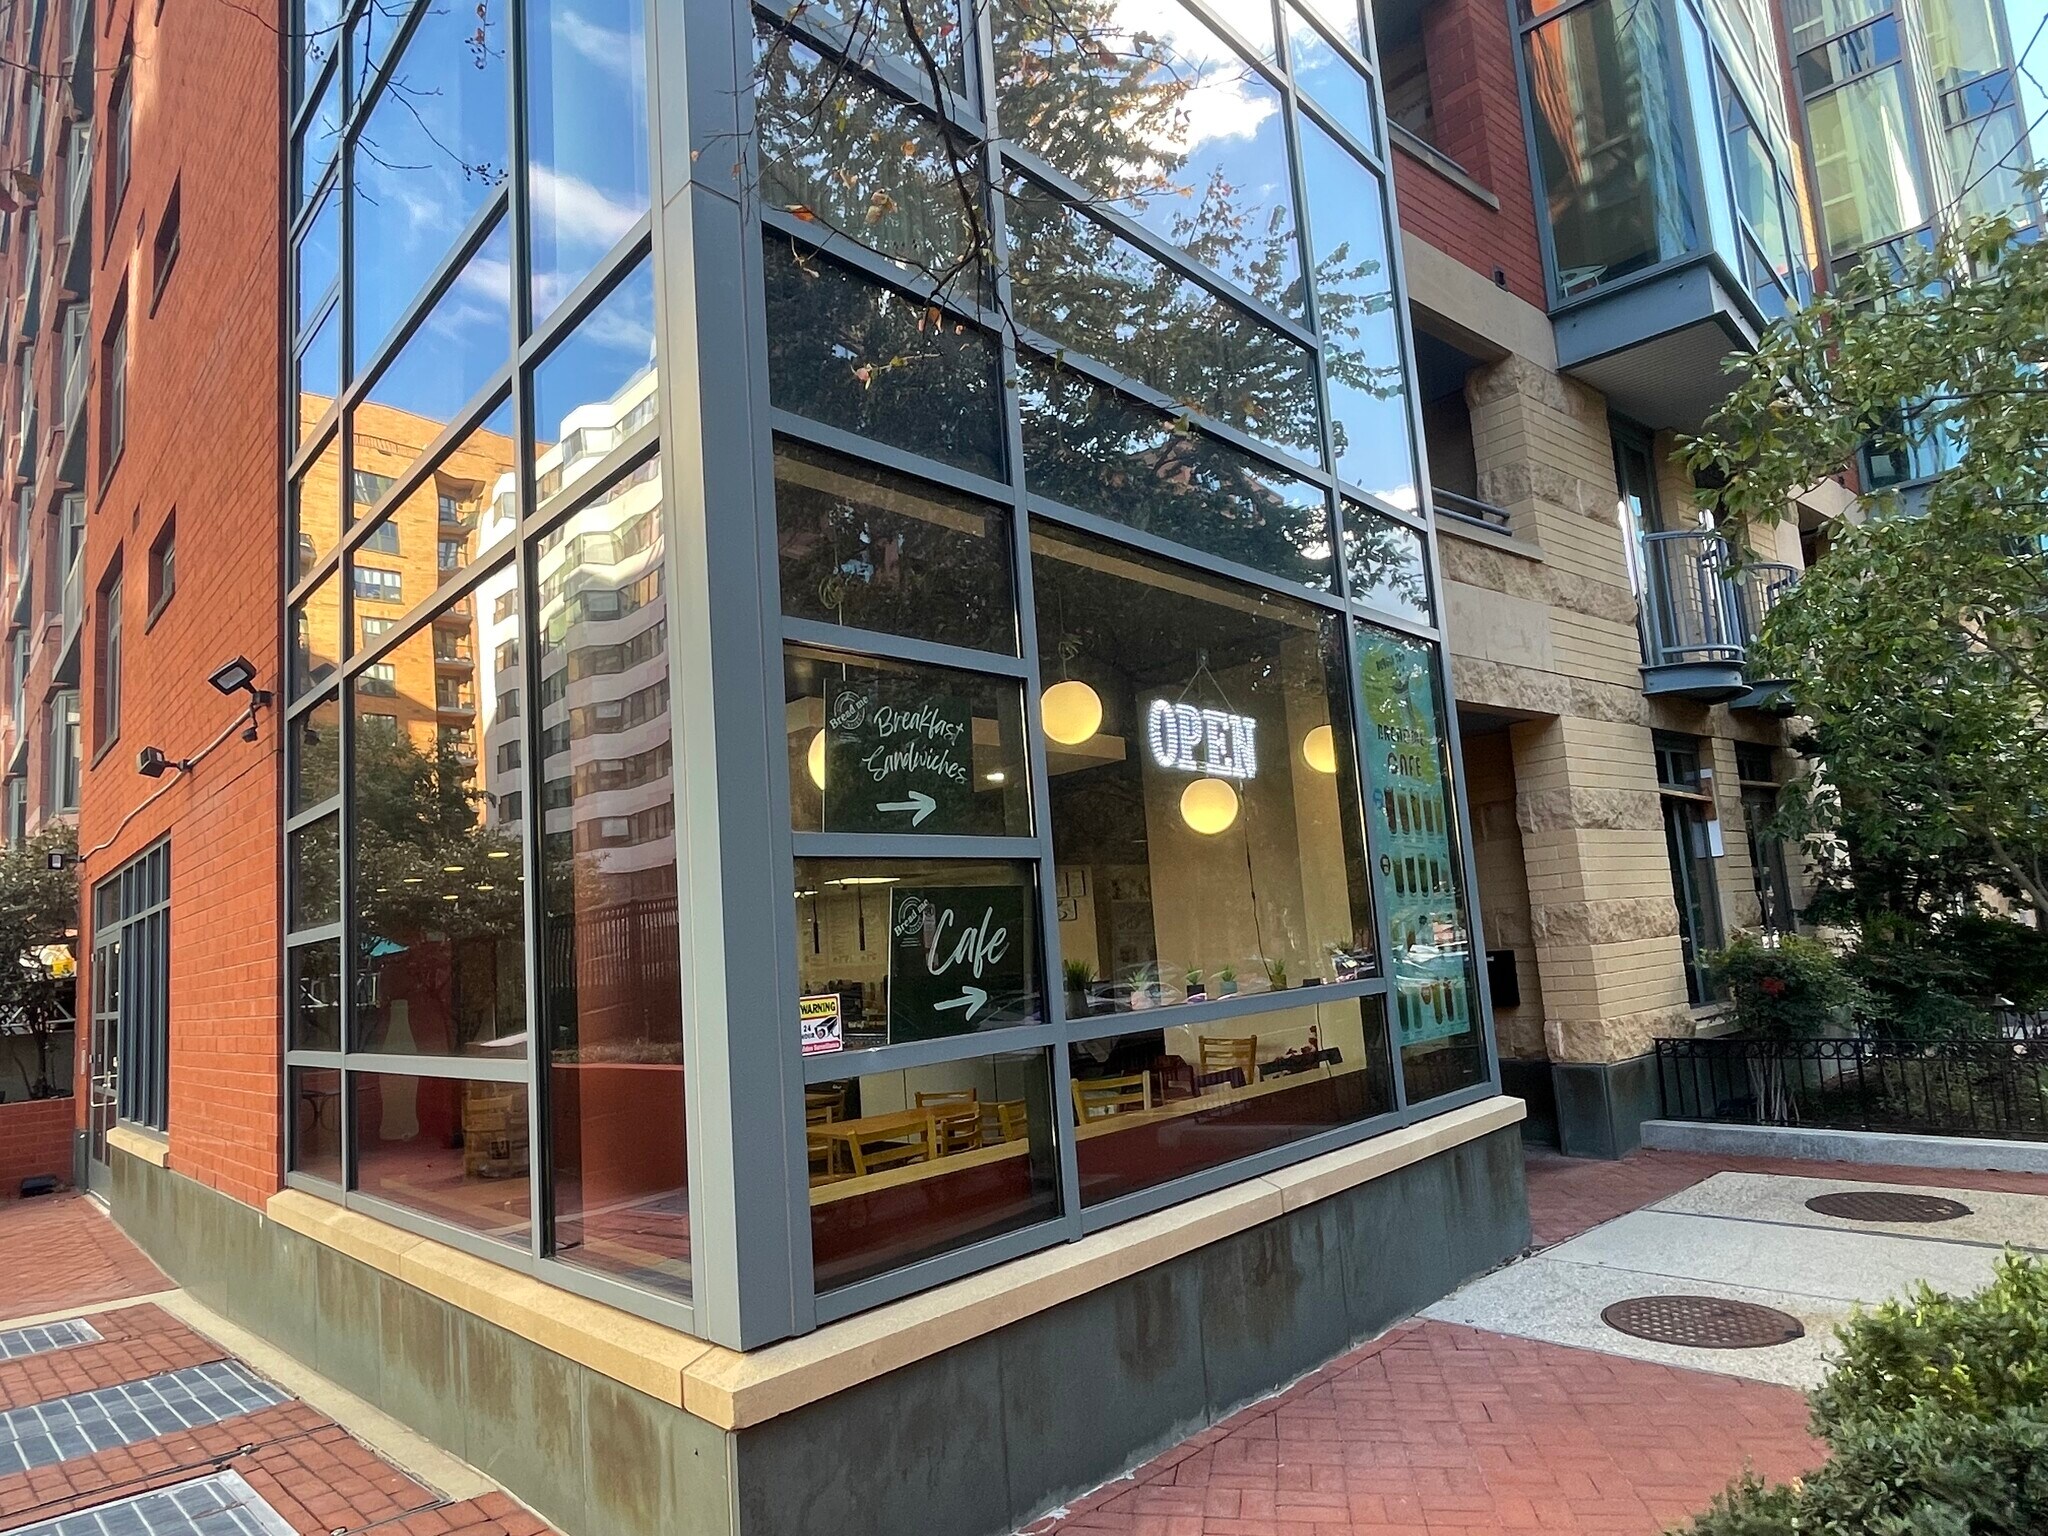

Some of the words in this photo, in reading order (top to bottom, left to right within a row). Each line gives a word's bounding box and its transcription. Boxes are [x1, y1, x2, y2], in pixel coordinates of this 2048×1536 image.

[829, 704, 857, 730] Bread
[873, 704, 965, 746] Breakfast
[1148, 699, 1257, 779] OPEN
[861, 742, 968, 784] Sandwiches
[894, 909, 918, 937] Bread
[926, 906, 1011, 979] Cafe
[800, 1001, 836, 1015] WARNING
